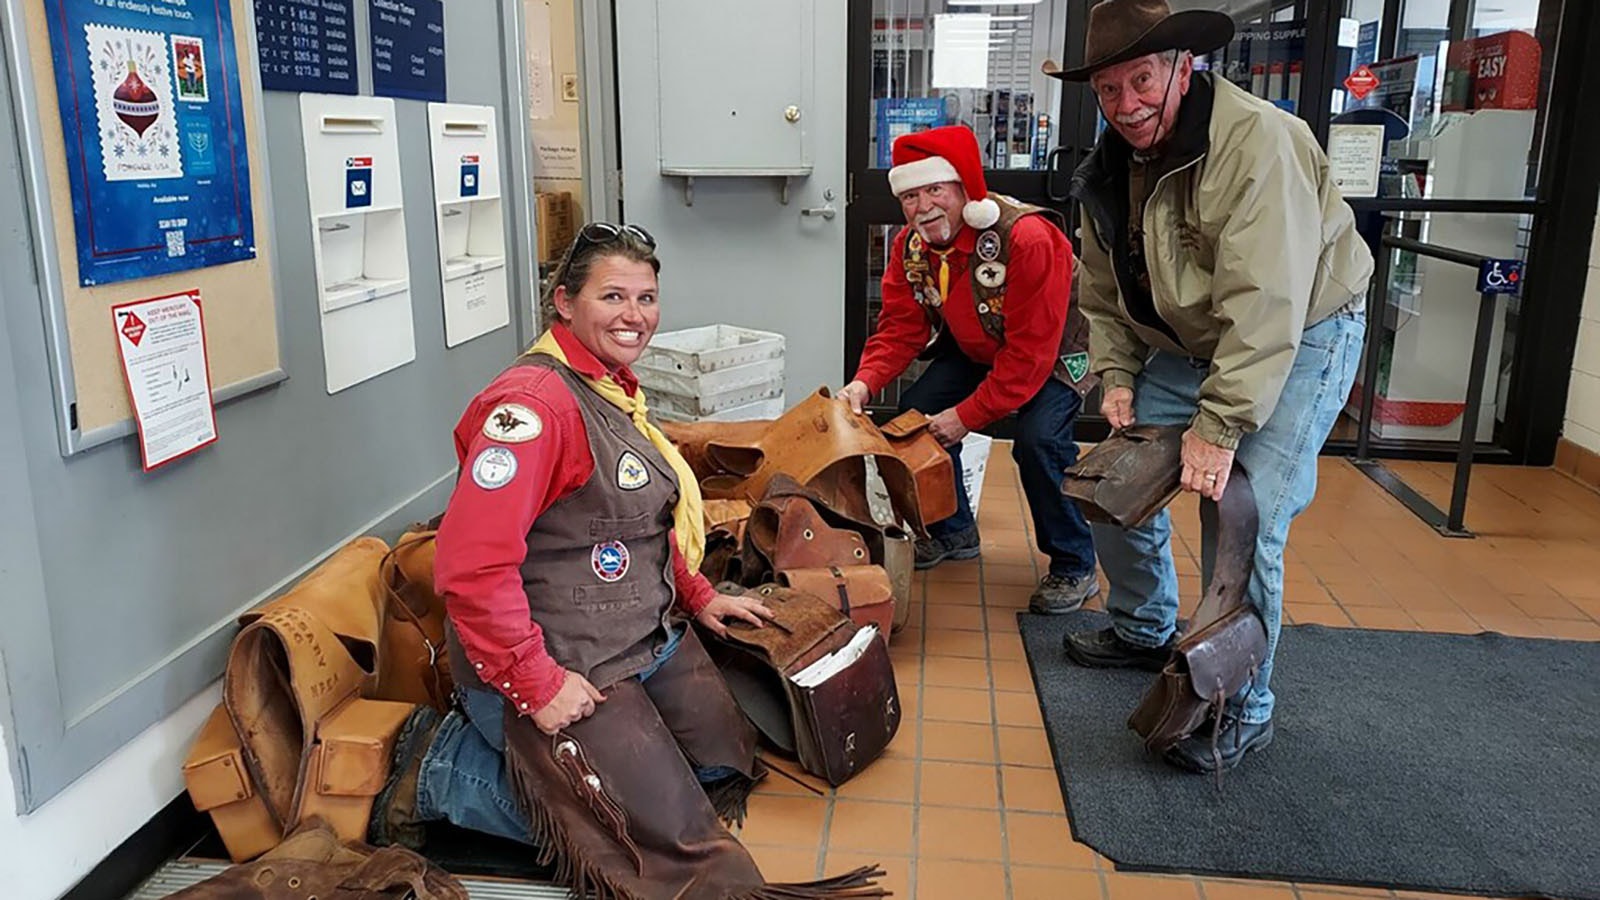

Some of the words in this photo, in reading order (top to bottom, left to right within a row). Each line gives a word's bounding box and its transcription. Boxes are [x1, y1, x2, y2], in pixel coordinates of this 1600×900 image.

[400, 2, 416, 16] Times
[1233, 30, 1271, 41] IPPING
[1477, 55, 1507, 79] EASY
[153, 195, 177, 203] Available
